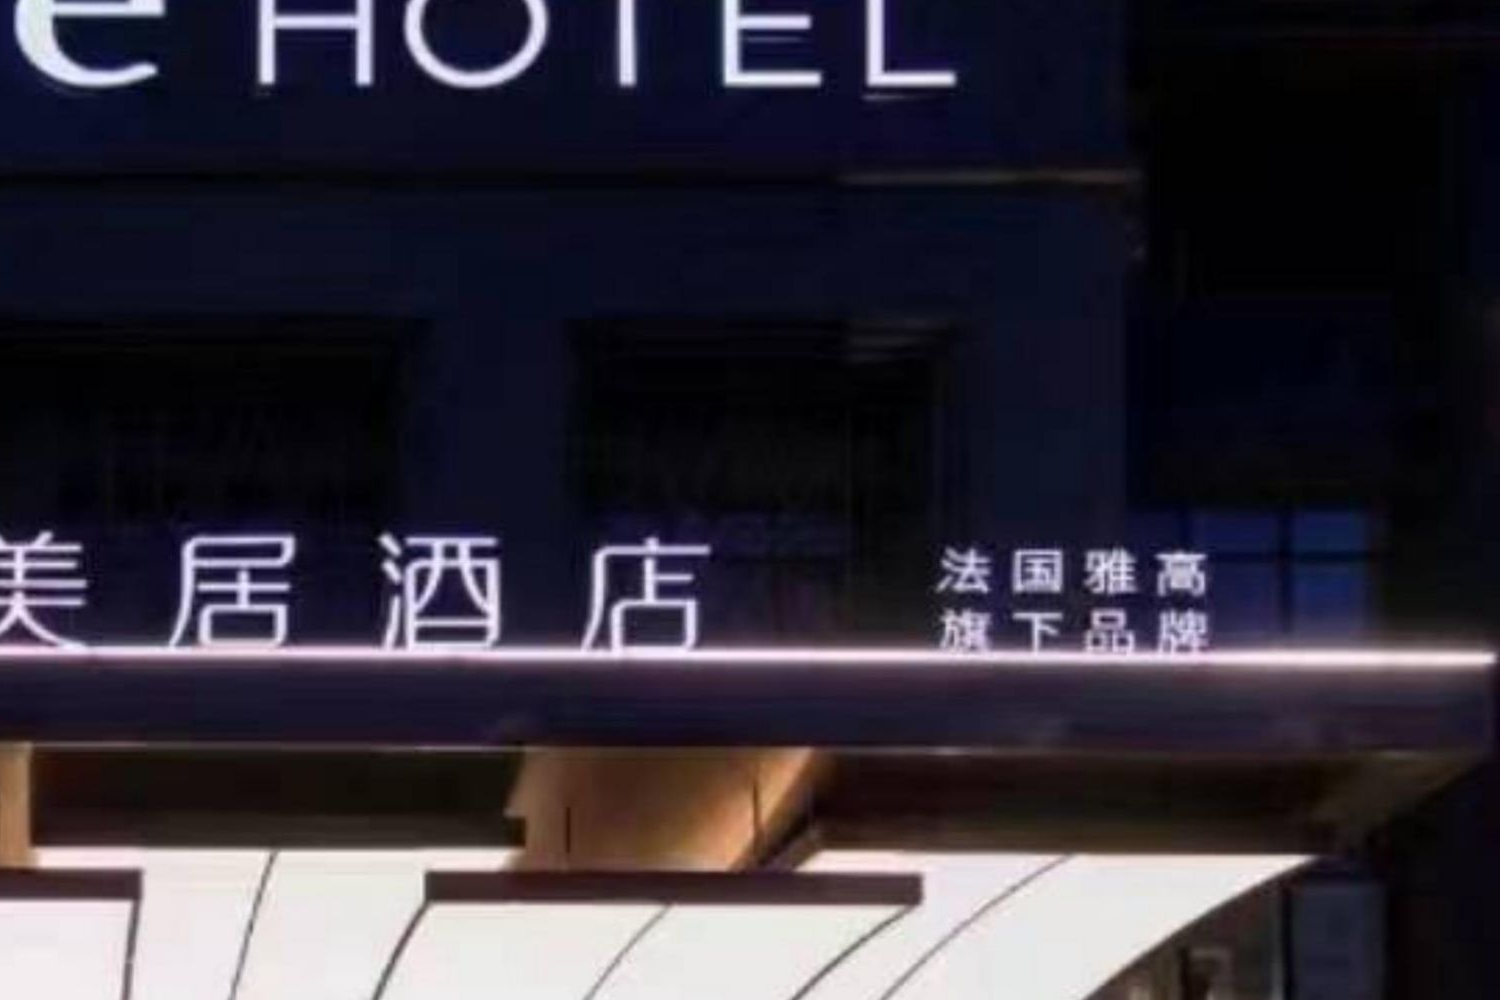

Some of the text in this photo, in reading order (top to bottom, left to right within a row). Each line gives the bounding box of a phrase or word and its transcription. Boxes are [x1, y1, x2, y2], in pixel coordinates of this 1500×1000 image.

[257, 0, 957, 88] HOTEL
[936, 547, 1208, 597] 法国雅高
[938, 608, 1210, 654] 旗下品牌
